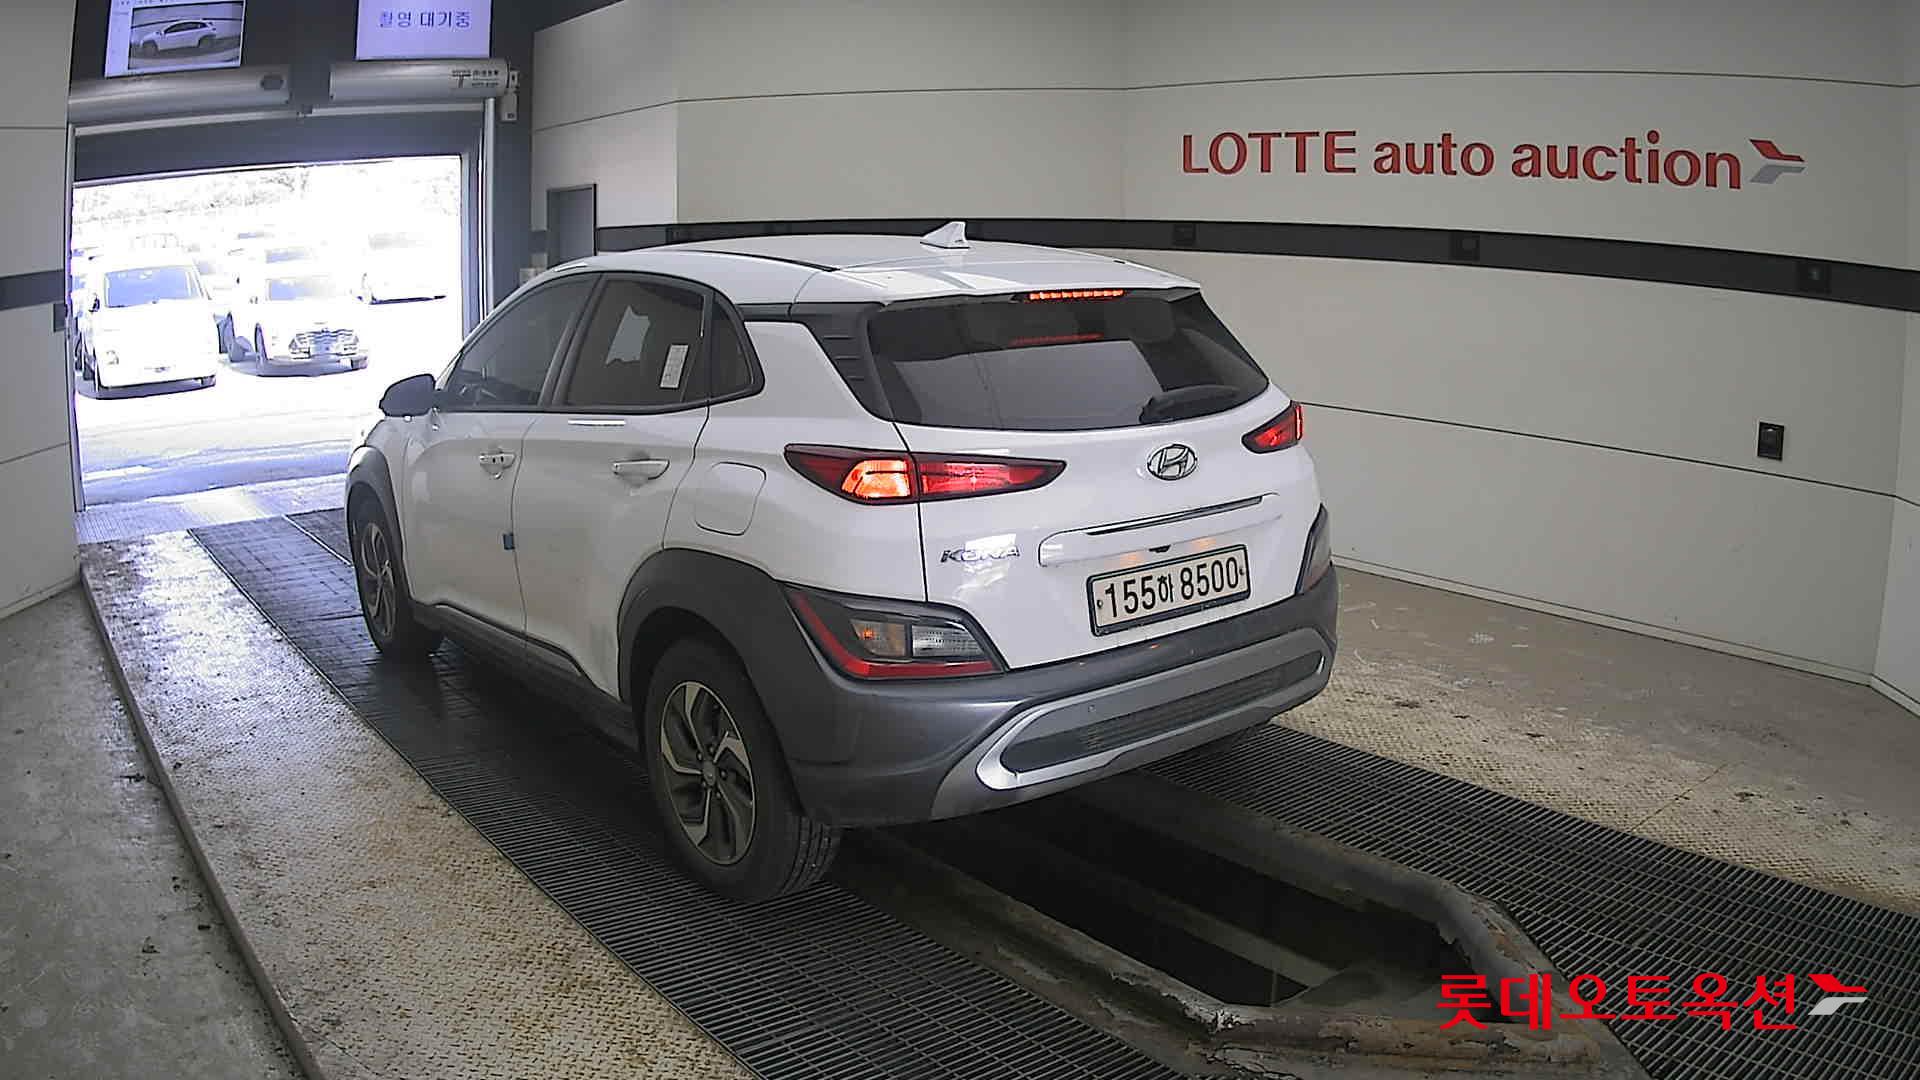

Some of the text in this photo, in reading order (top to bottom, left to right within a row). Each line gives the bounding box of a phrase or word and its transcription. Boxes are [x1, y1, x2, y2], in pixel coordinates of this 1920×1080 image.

[420, 11, 471, 28] 대기중
[1182, 130, 1741, 189] LOTTE auto auction
[1104, 556, 1239, 618] 155하 8500
